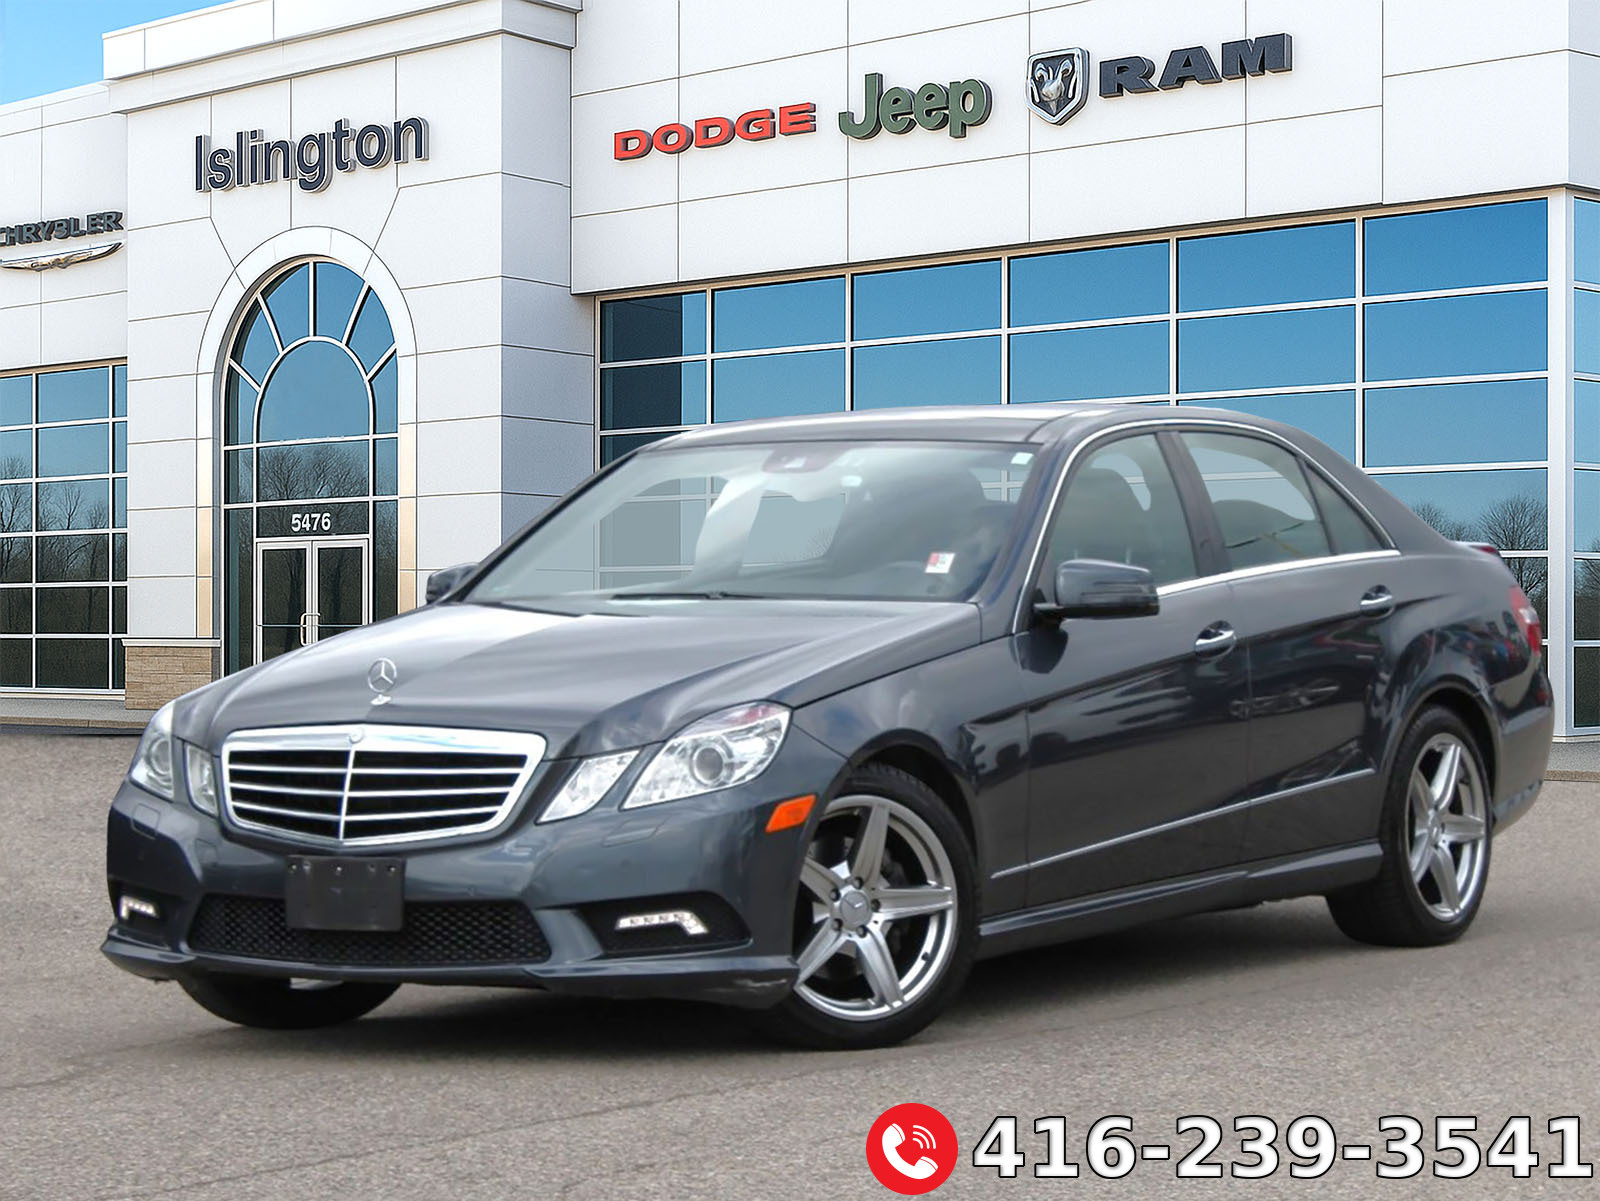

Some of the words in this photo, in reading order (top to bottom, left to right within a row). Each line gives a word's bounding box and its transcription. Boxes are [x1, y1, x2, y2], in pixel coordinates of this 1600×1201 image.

[614, 102, 816, 161] DODGE
[839, 72, 992, 139] Jeep
[1099, 33, 1293, 98] RAM
[195, 116, 429, 193] Islington
[291, 512, 331, 532] 5476
